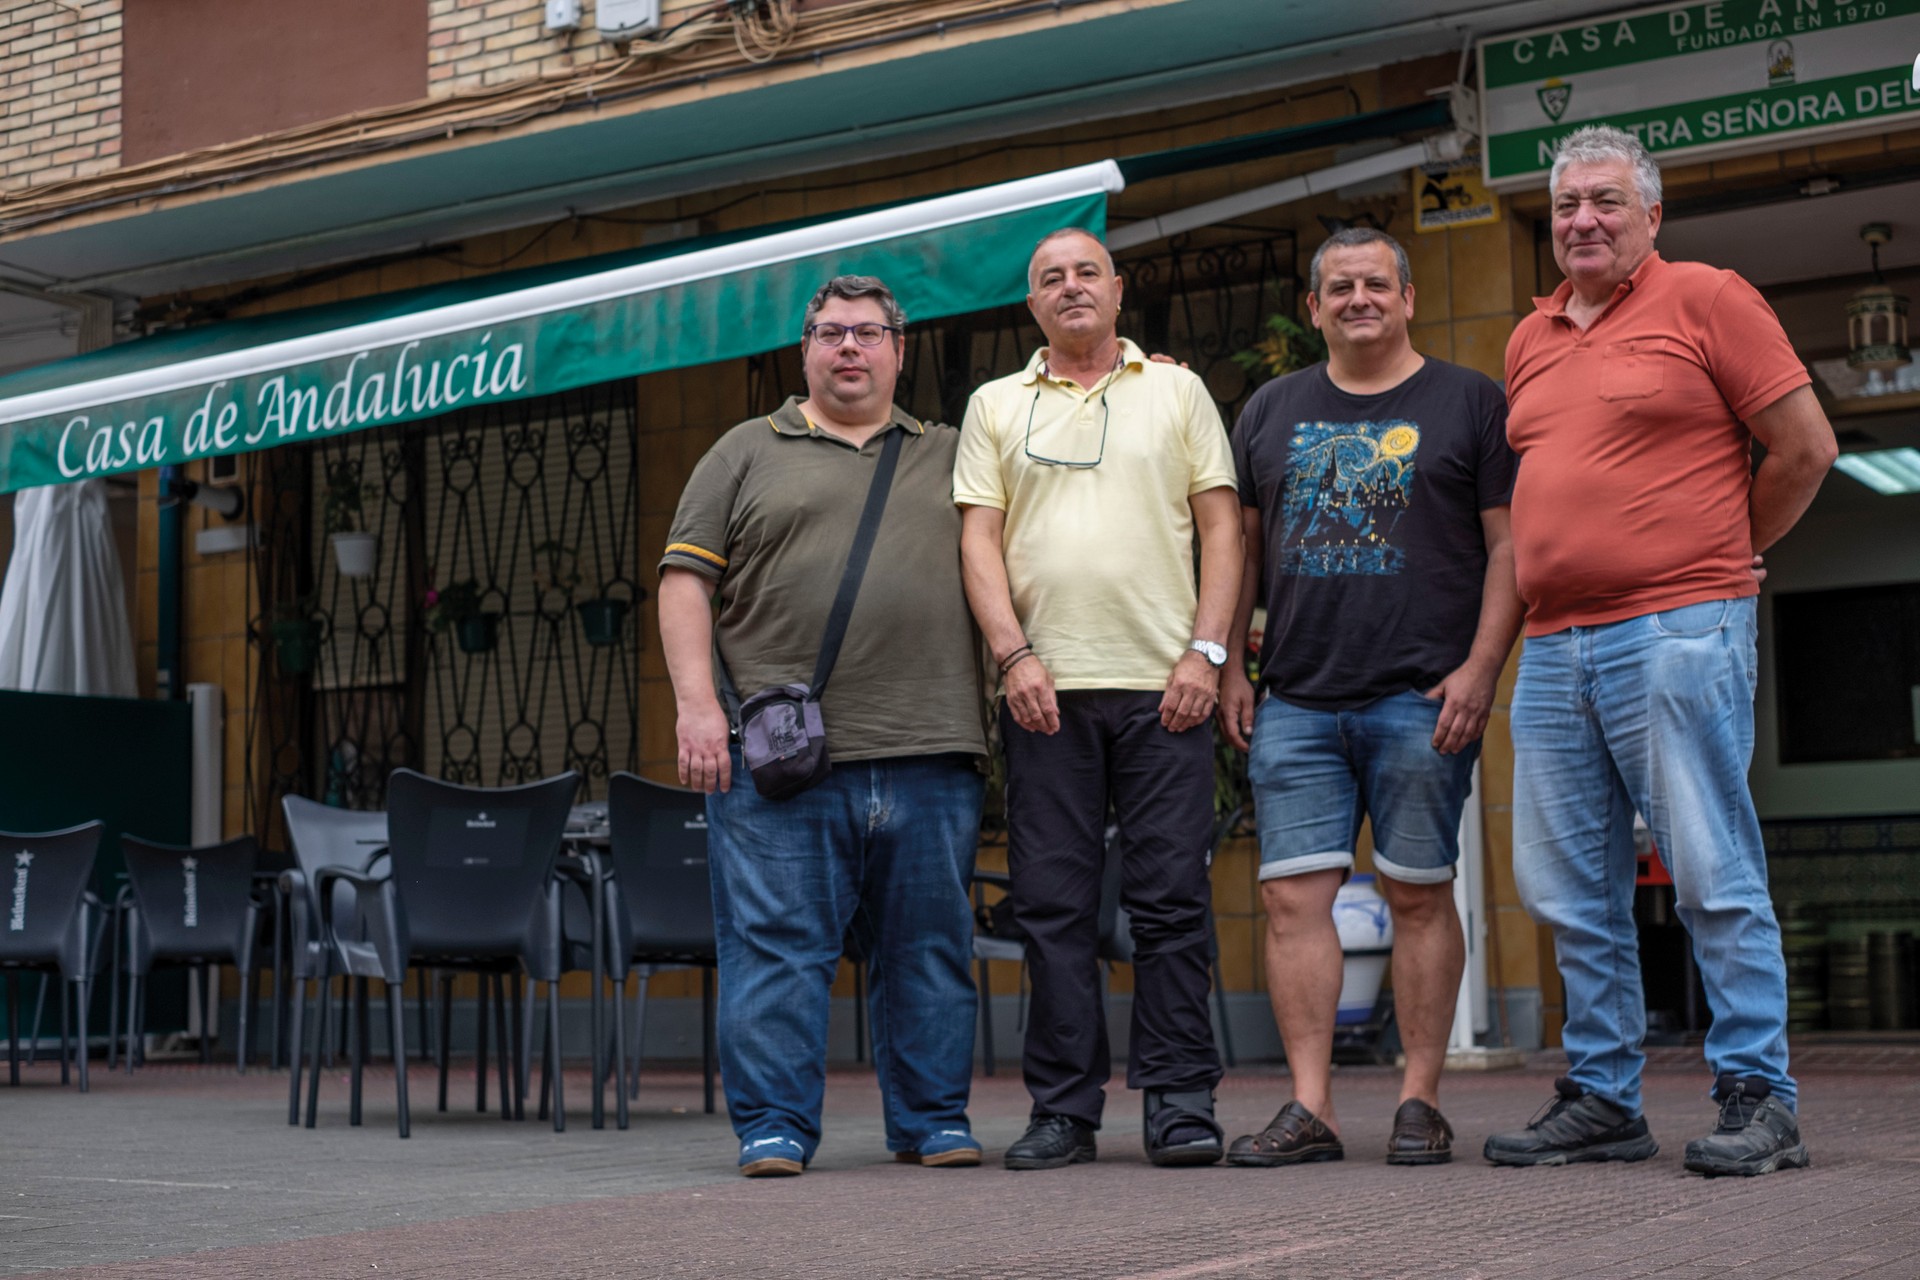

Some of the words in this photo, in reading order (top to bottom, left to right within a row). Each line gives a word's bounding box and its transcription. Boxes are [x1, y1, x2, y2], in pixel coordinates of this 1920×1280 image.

[1512, 19, 1637, 64] CASA
[1668, 2, 1726, 37] DE
[1676, 21, 1783, 52] FUNDADA
[1793, 11, 1822, 32] EN
[1833, 1, 1886, 24] 1970
[1536, 115, 1694, 166] NTRA
[1701, 90, 1846, 139] SEÑORA
[1854, 78, 1920, 114] DEL
[56, 415, 168, 478] Casa
[182, 381, 239, 456] de
[244, 331, 528, 446] Andalucía
